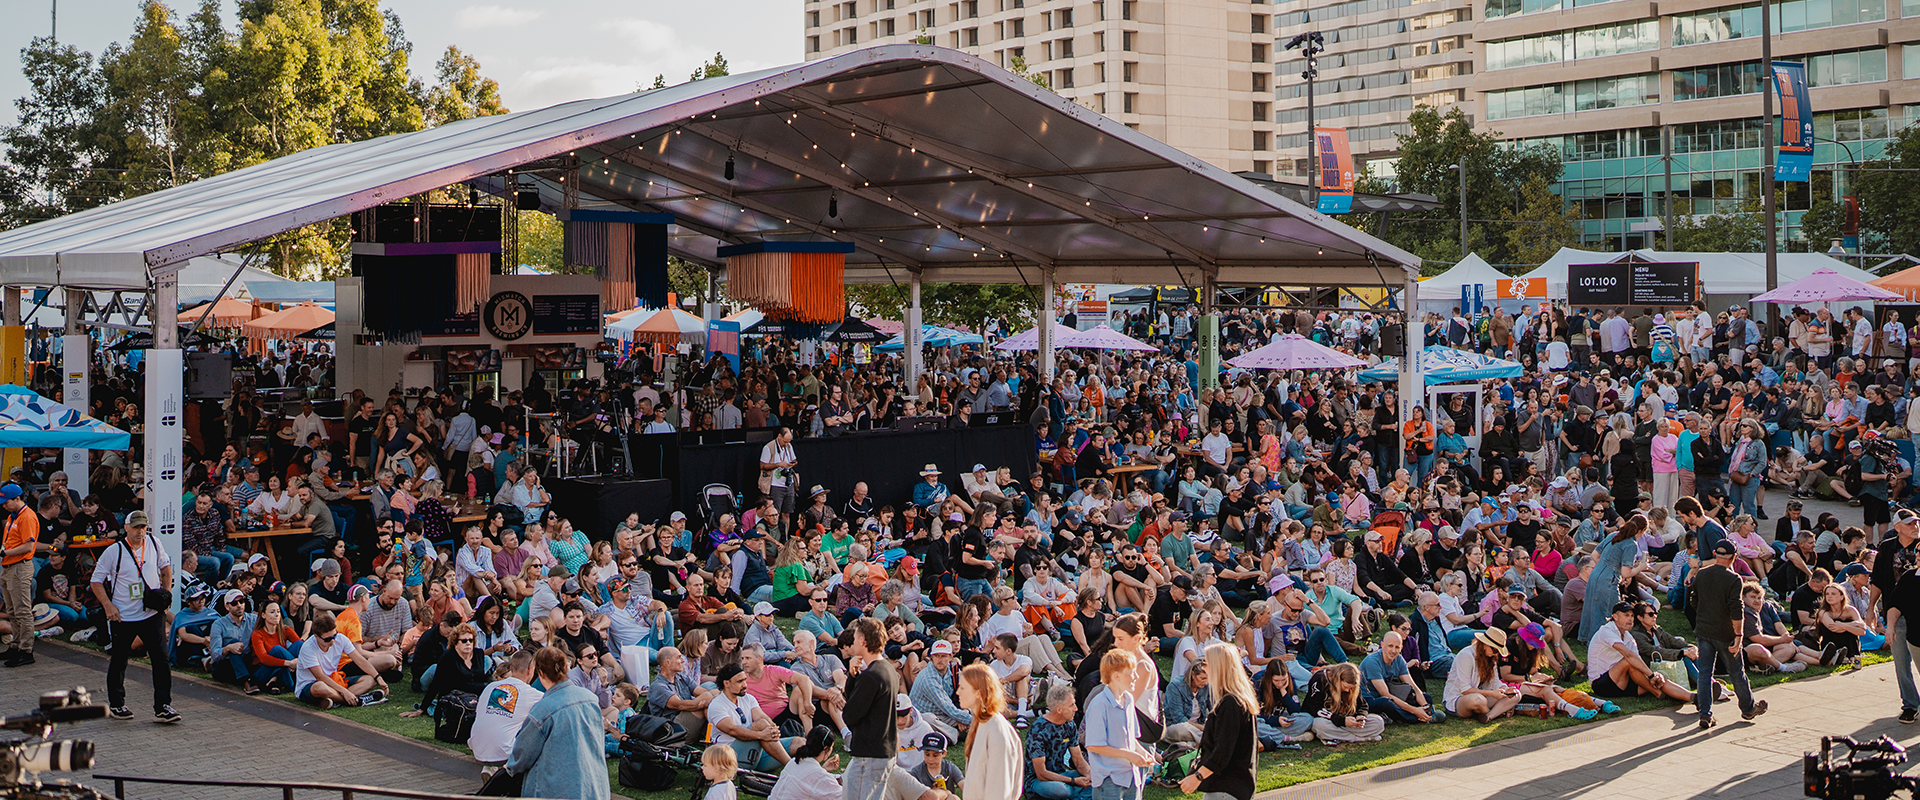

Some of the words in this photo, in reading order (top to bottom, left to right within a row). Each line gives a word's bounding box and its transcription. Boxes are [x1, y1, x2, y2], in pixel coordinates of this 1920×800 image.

[1781, 95, 1800, 120] DOWN
[1782, 119, 1801, 144] UNDER
[1318, 136, 1334, 152] TOUR
[1321, 152, 1339, 170] DOWN
[1322, 169, 1341, 187] UNDER
[1580, 276, 1617, 287] LOT.100
[493, 293, 526, 305] MISMATCH
[491, 325, 520, 339] BREWING
